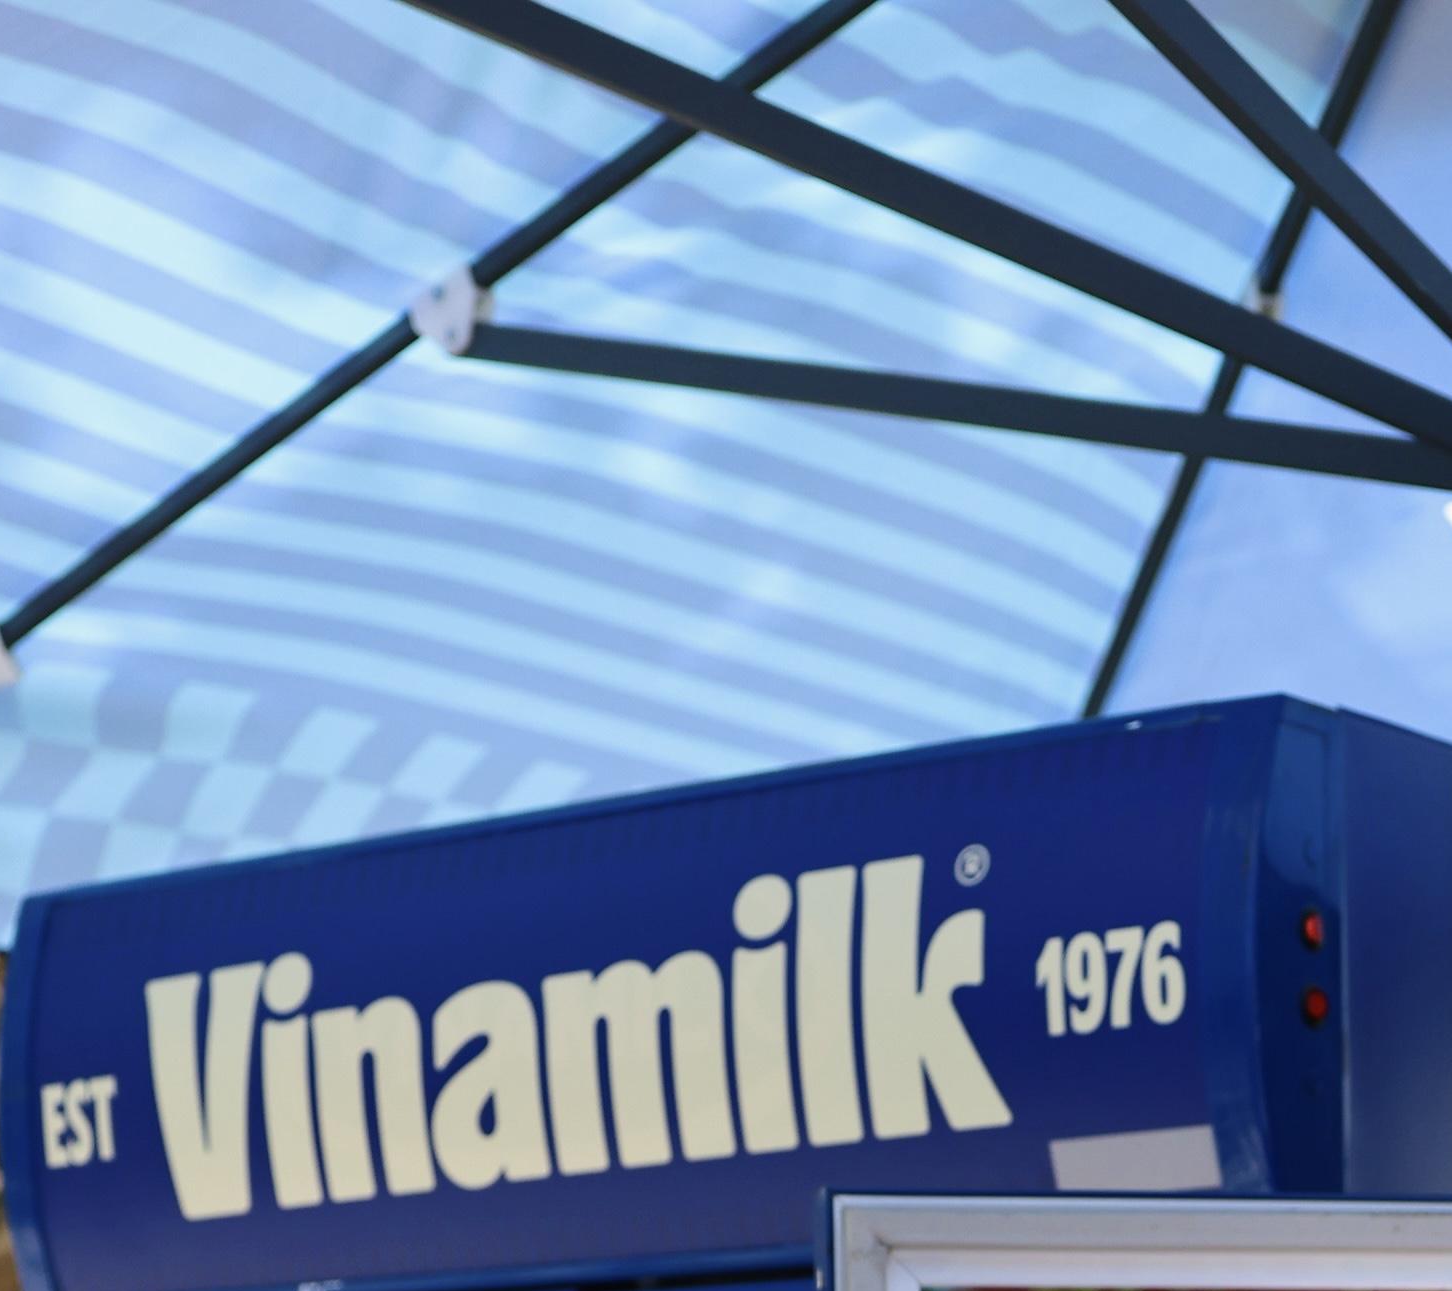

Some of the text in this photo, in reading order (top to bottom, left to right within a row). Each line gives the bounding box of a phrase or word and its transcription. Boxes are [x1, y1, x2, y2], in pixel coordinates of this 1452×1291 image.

[40, 854, 1186, 1222] EST Vinamilk 1976
